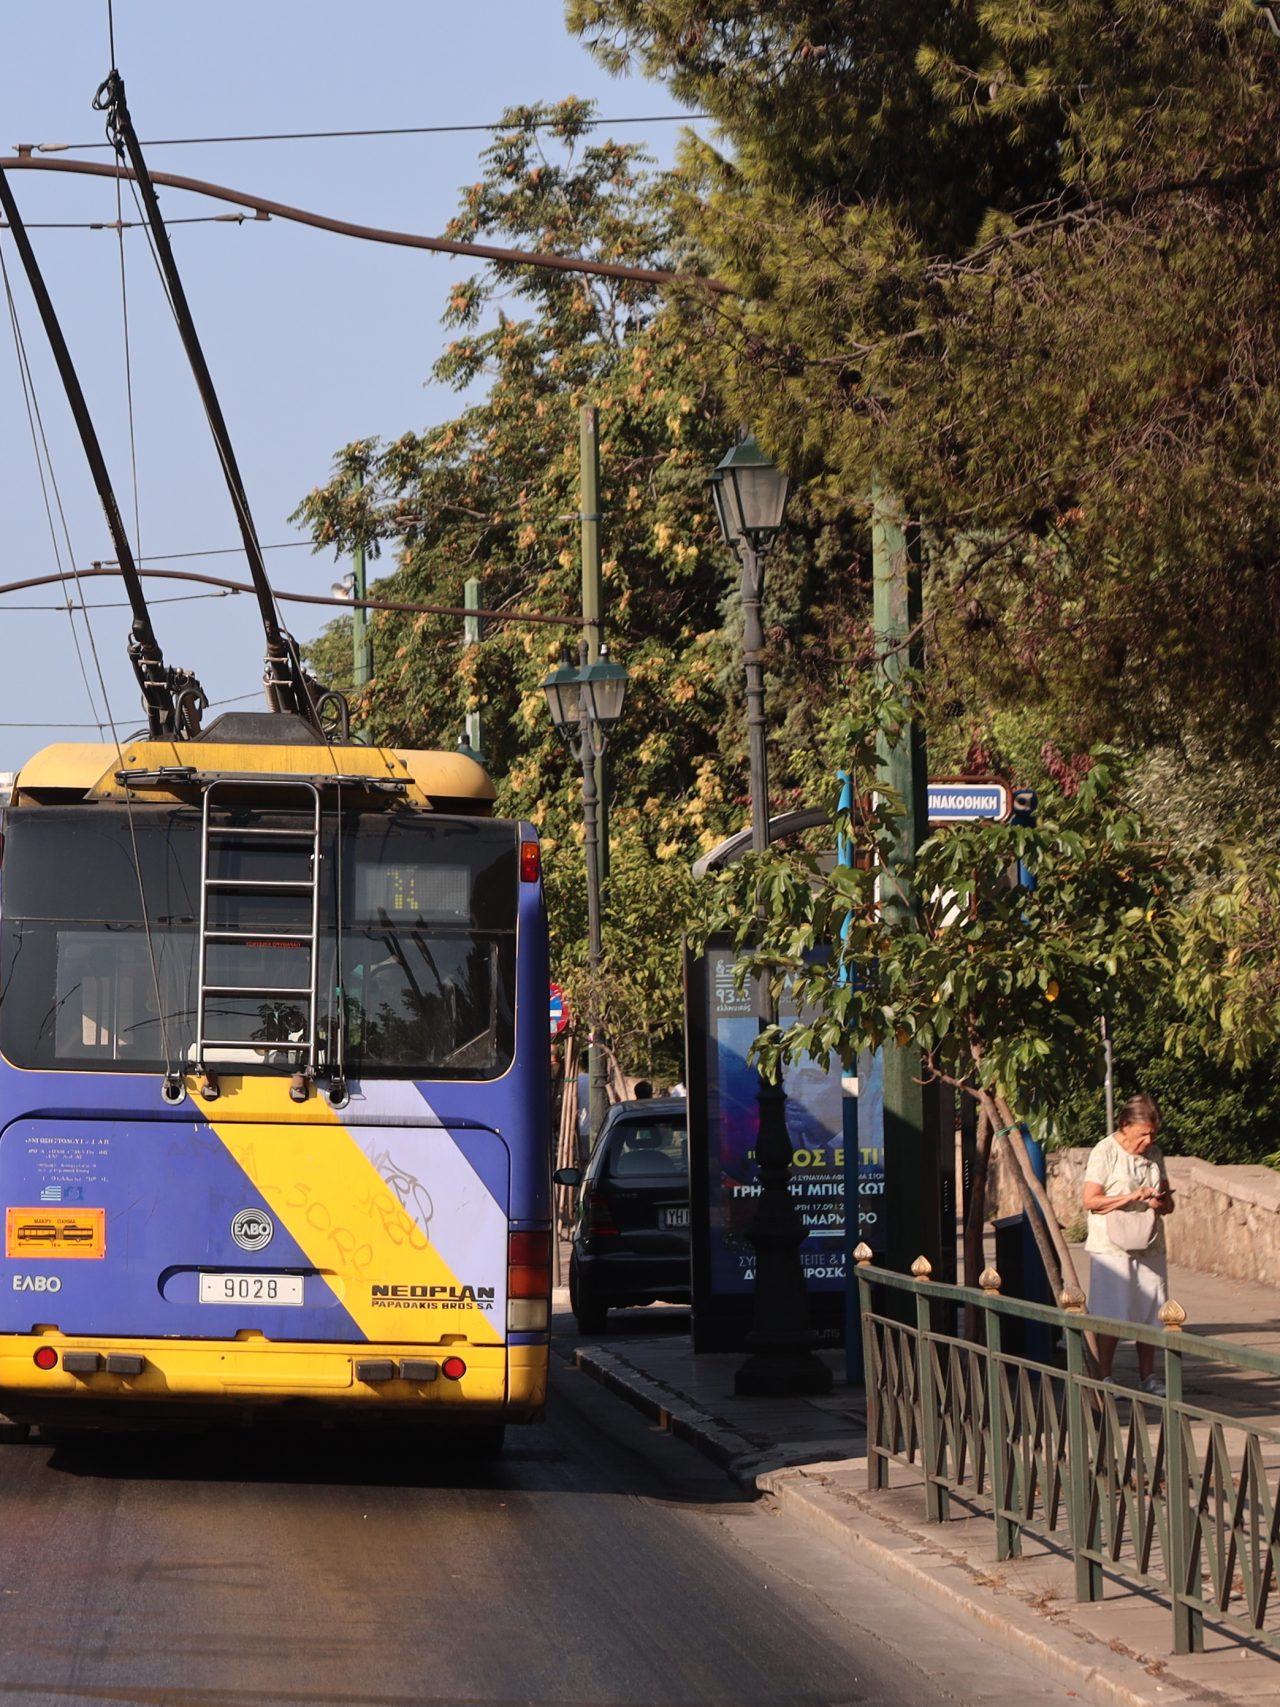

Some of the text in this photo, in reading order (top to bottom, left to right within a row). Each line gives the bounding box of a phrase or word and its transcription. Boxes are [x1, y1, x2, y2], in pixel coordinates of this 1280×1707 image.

[928, 795, 997, 810] ΙΝΑΚΟΘΗΚΗ
[234, 1222, 271, 1236] ΕΛΒΟ
[12, 1274, 62, 1293] ΕΛΒΟ
[224, 1278, 278, 1299] 9028
[371, 1284, 495, 1302] NEOPLAN
[371, 1301, 438, 1310] PAPADAKIS
[441, 1302, 473, 1310] BROS
